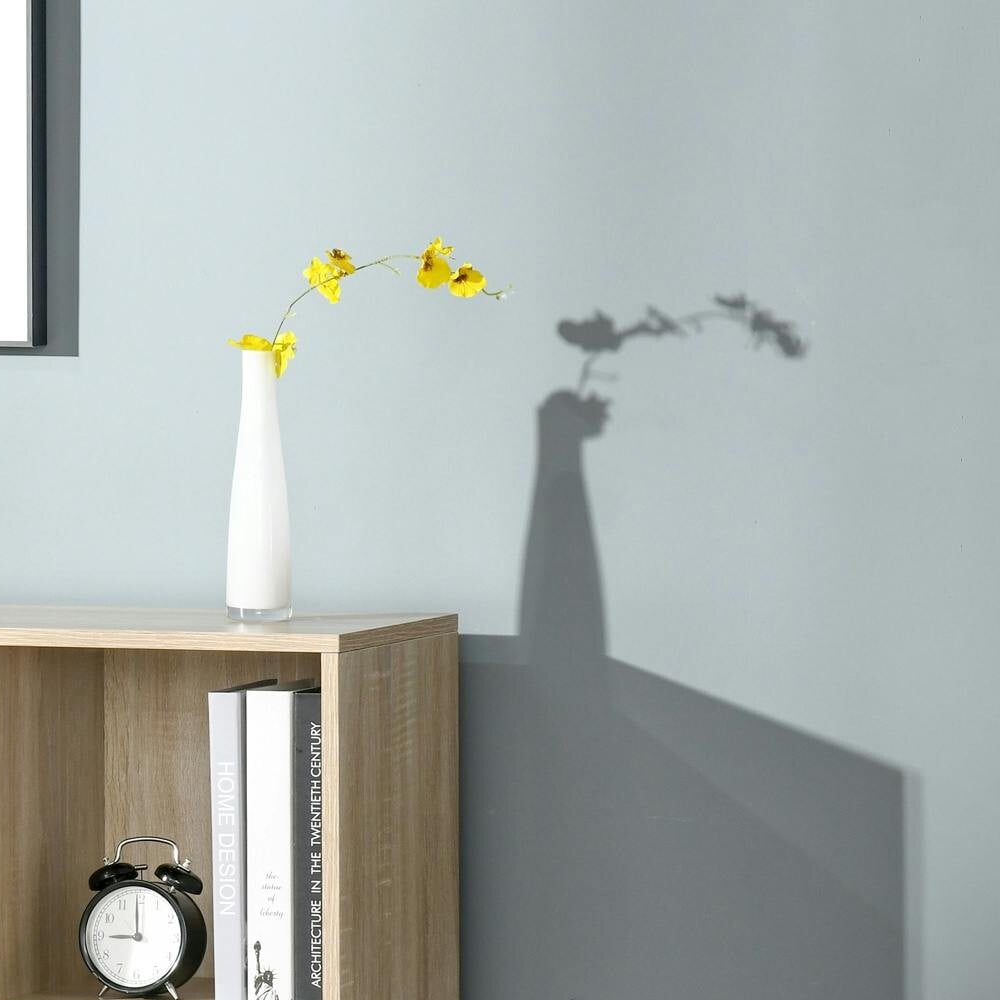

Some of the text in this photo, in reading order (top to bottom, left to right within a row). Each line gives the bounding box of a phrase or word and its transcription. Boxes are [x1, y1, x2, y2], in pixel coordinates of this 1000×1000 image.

[217, 762, 235, 826] HOME
[310, 721, 322, 988] ARCHITECTURE IN THE TWENTIETH CENTURY
